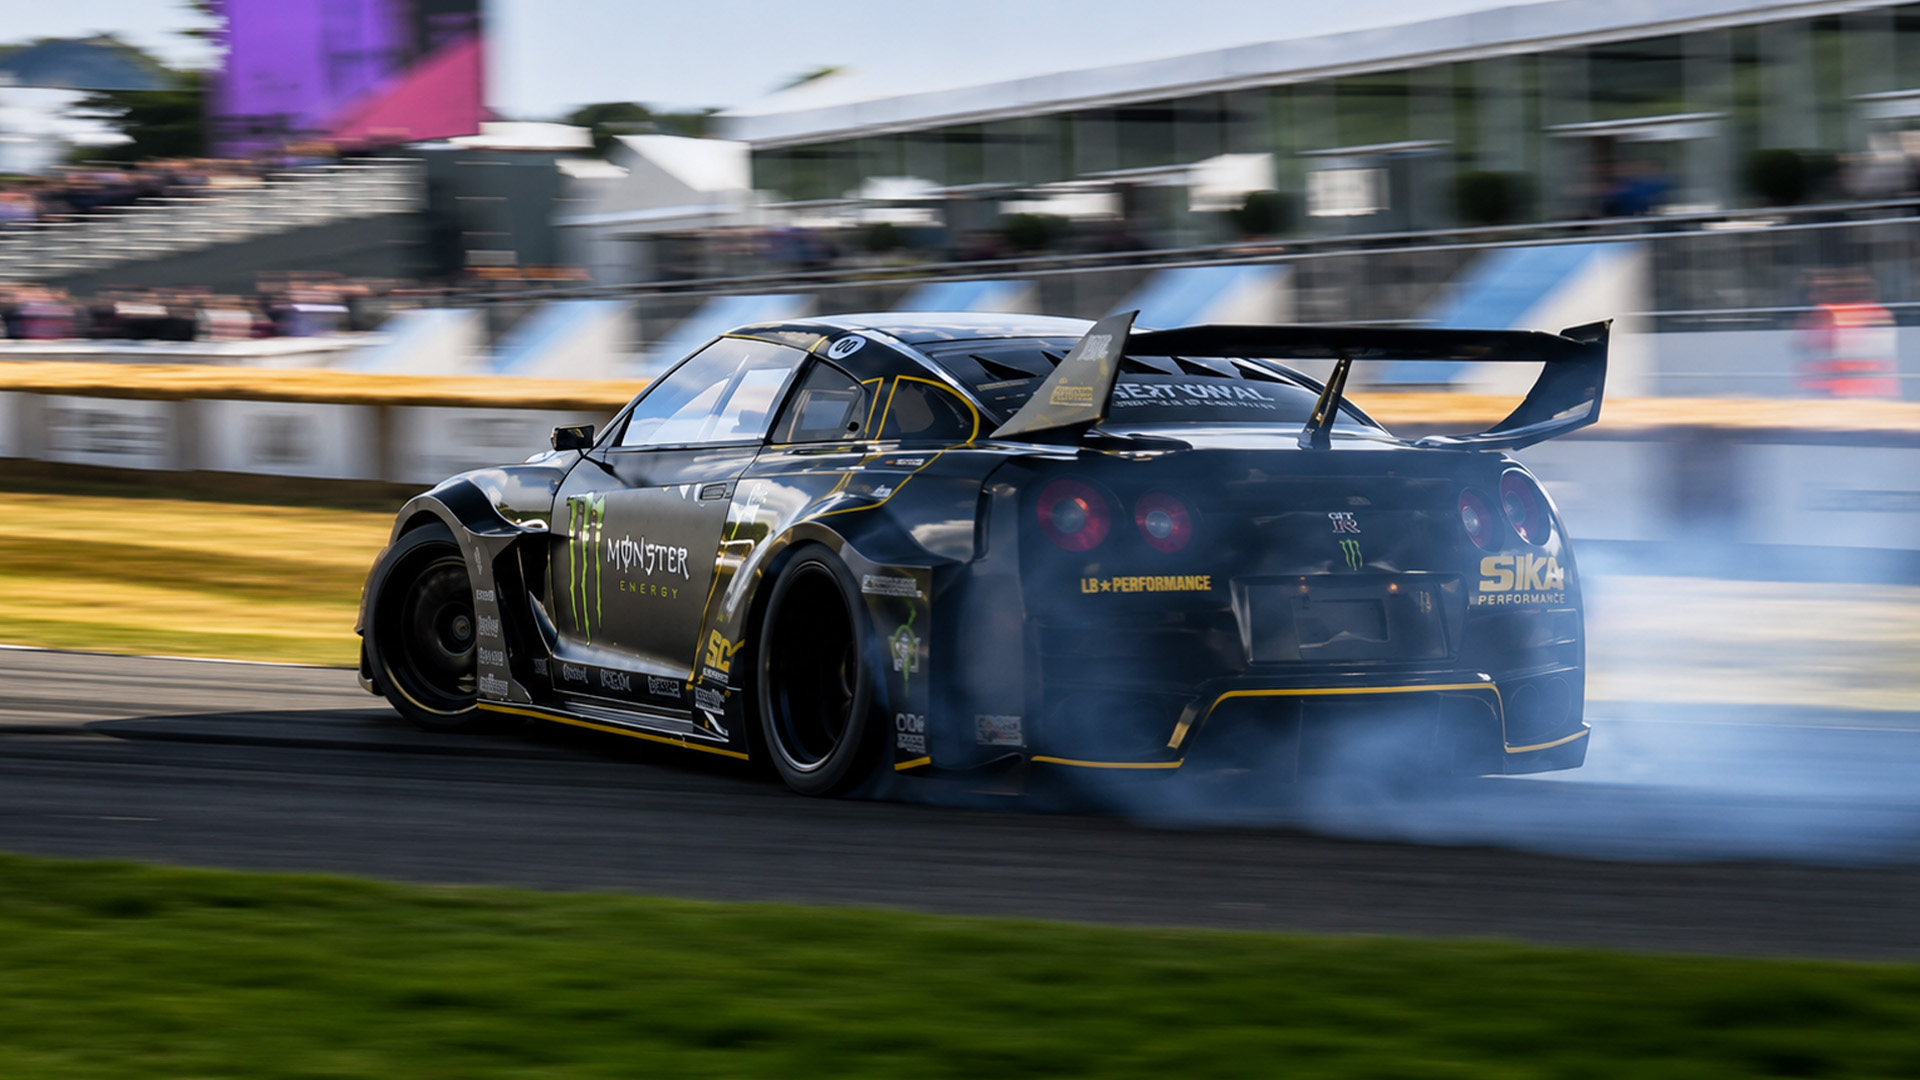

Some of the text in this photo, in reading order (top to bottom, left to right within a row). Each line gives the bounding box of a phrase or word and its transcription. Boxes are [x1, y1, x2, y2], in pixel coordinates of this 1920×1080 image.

[606, 535, 690, 580] MONSTER
[1479, 553, 1565, 592] SIKA
[619, 579, 678, 599] ENERGY
[1478, 593, 1565, 605] PERFORMANCE
